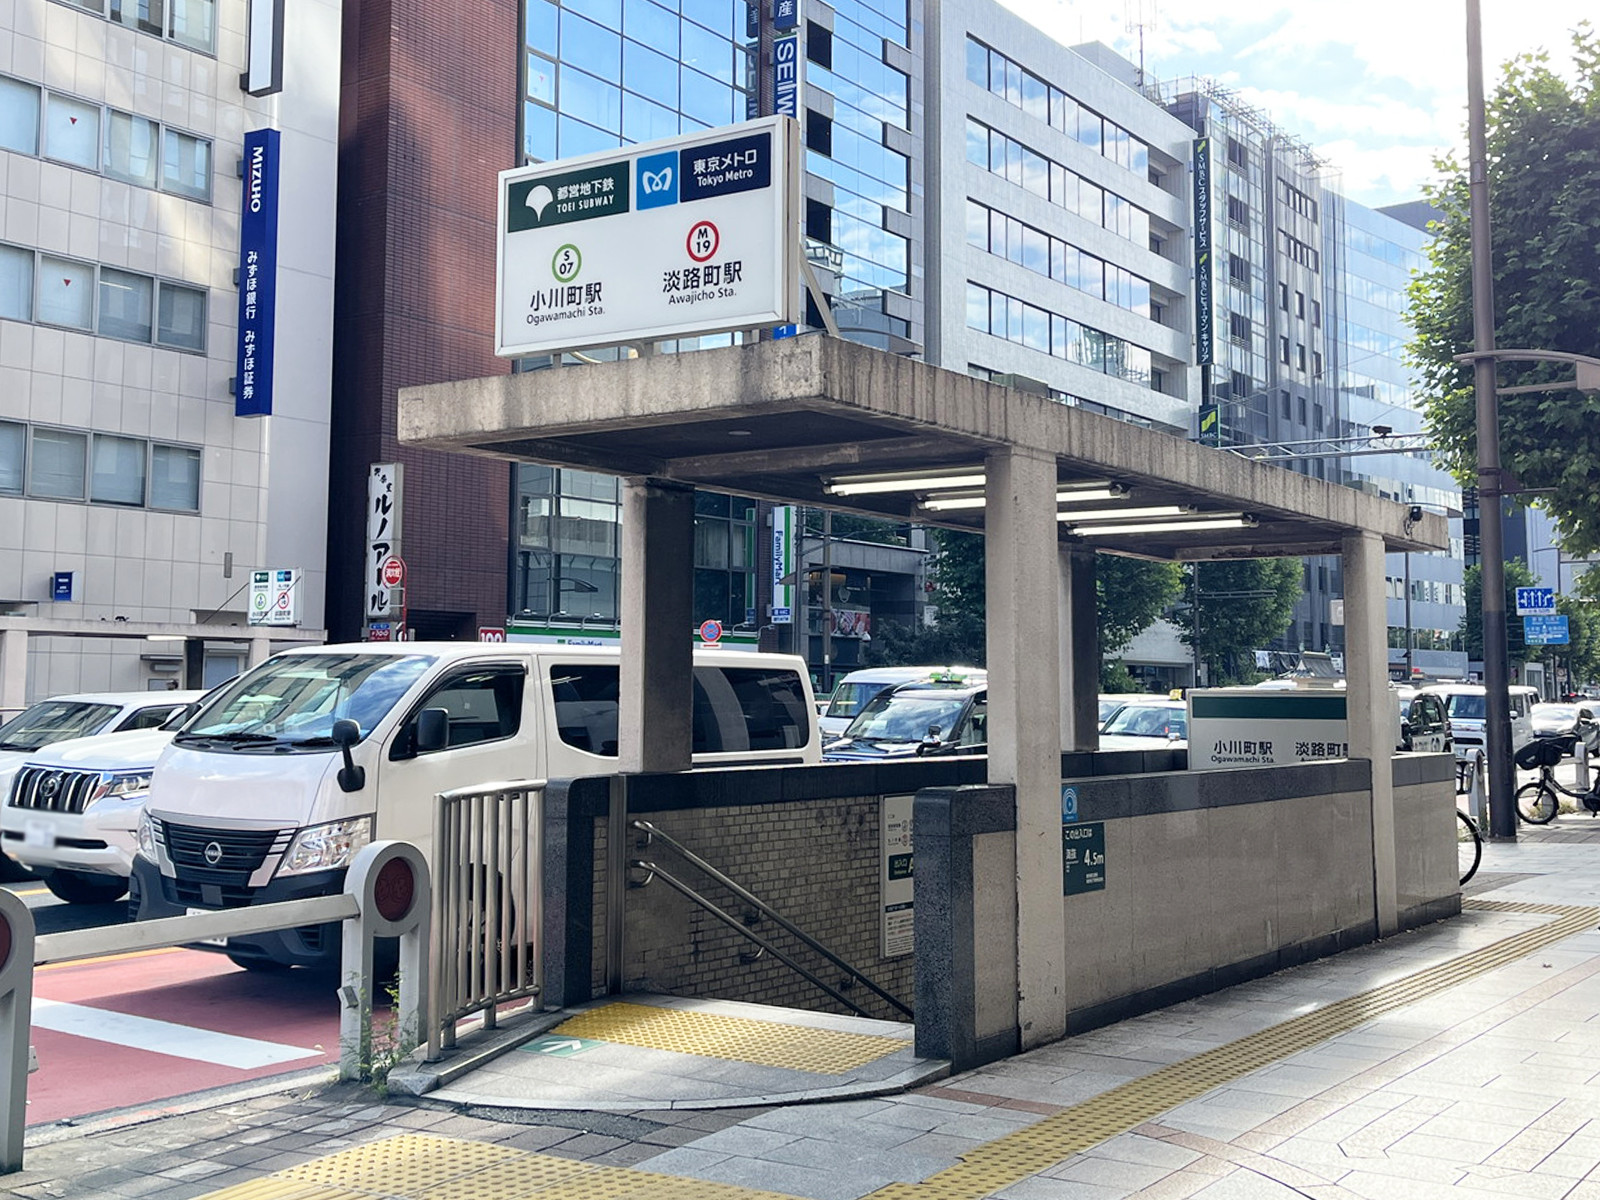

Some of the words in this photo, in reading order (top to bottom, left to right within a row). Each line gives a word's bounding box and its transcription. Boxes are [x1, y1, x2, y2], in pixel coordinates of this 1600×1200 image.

[693, 149, 757, 175] 東京メトロ
[249, 146, 264, 213] MIZUHO
[697, 174, 723, 187] Tokyo
[725, 167, 754, 182] Metro
[557, 177, 615, 201] 都営地下鉄
[557, 202, 576, 214] TOEI
[578, 194, 615, 211] SUBWAY
[697, 228, 708, 240] M
[563, 250, 570, 262] S
[696, 240, 711, 253] 19
[559, 262, 574, 275] 07
[662, 261, 743, 293] 淡路町駅
[245, 251, 258, 320] みずほ銀行
[668, 290, 715, 305] Awajicho
[718, 286, 737, 298] Sta.
[529, 282, 602, 312] 小川町駅
[526, 306, 586, 326] Ogawamachi
[588, 304, 606, 316] Sta.
[243, 331, 255, 399] みずほ証券
[370, 493, 393, 612] ルノアール
[1213, 740, 1273, 755] 小川町駅
[1210, 755, 1260, 764] Ogawamachi
[1084, 849, 1104, 866] 4.5m
